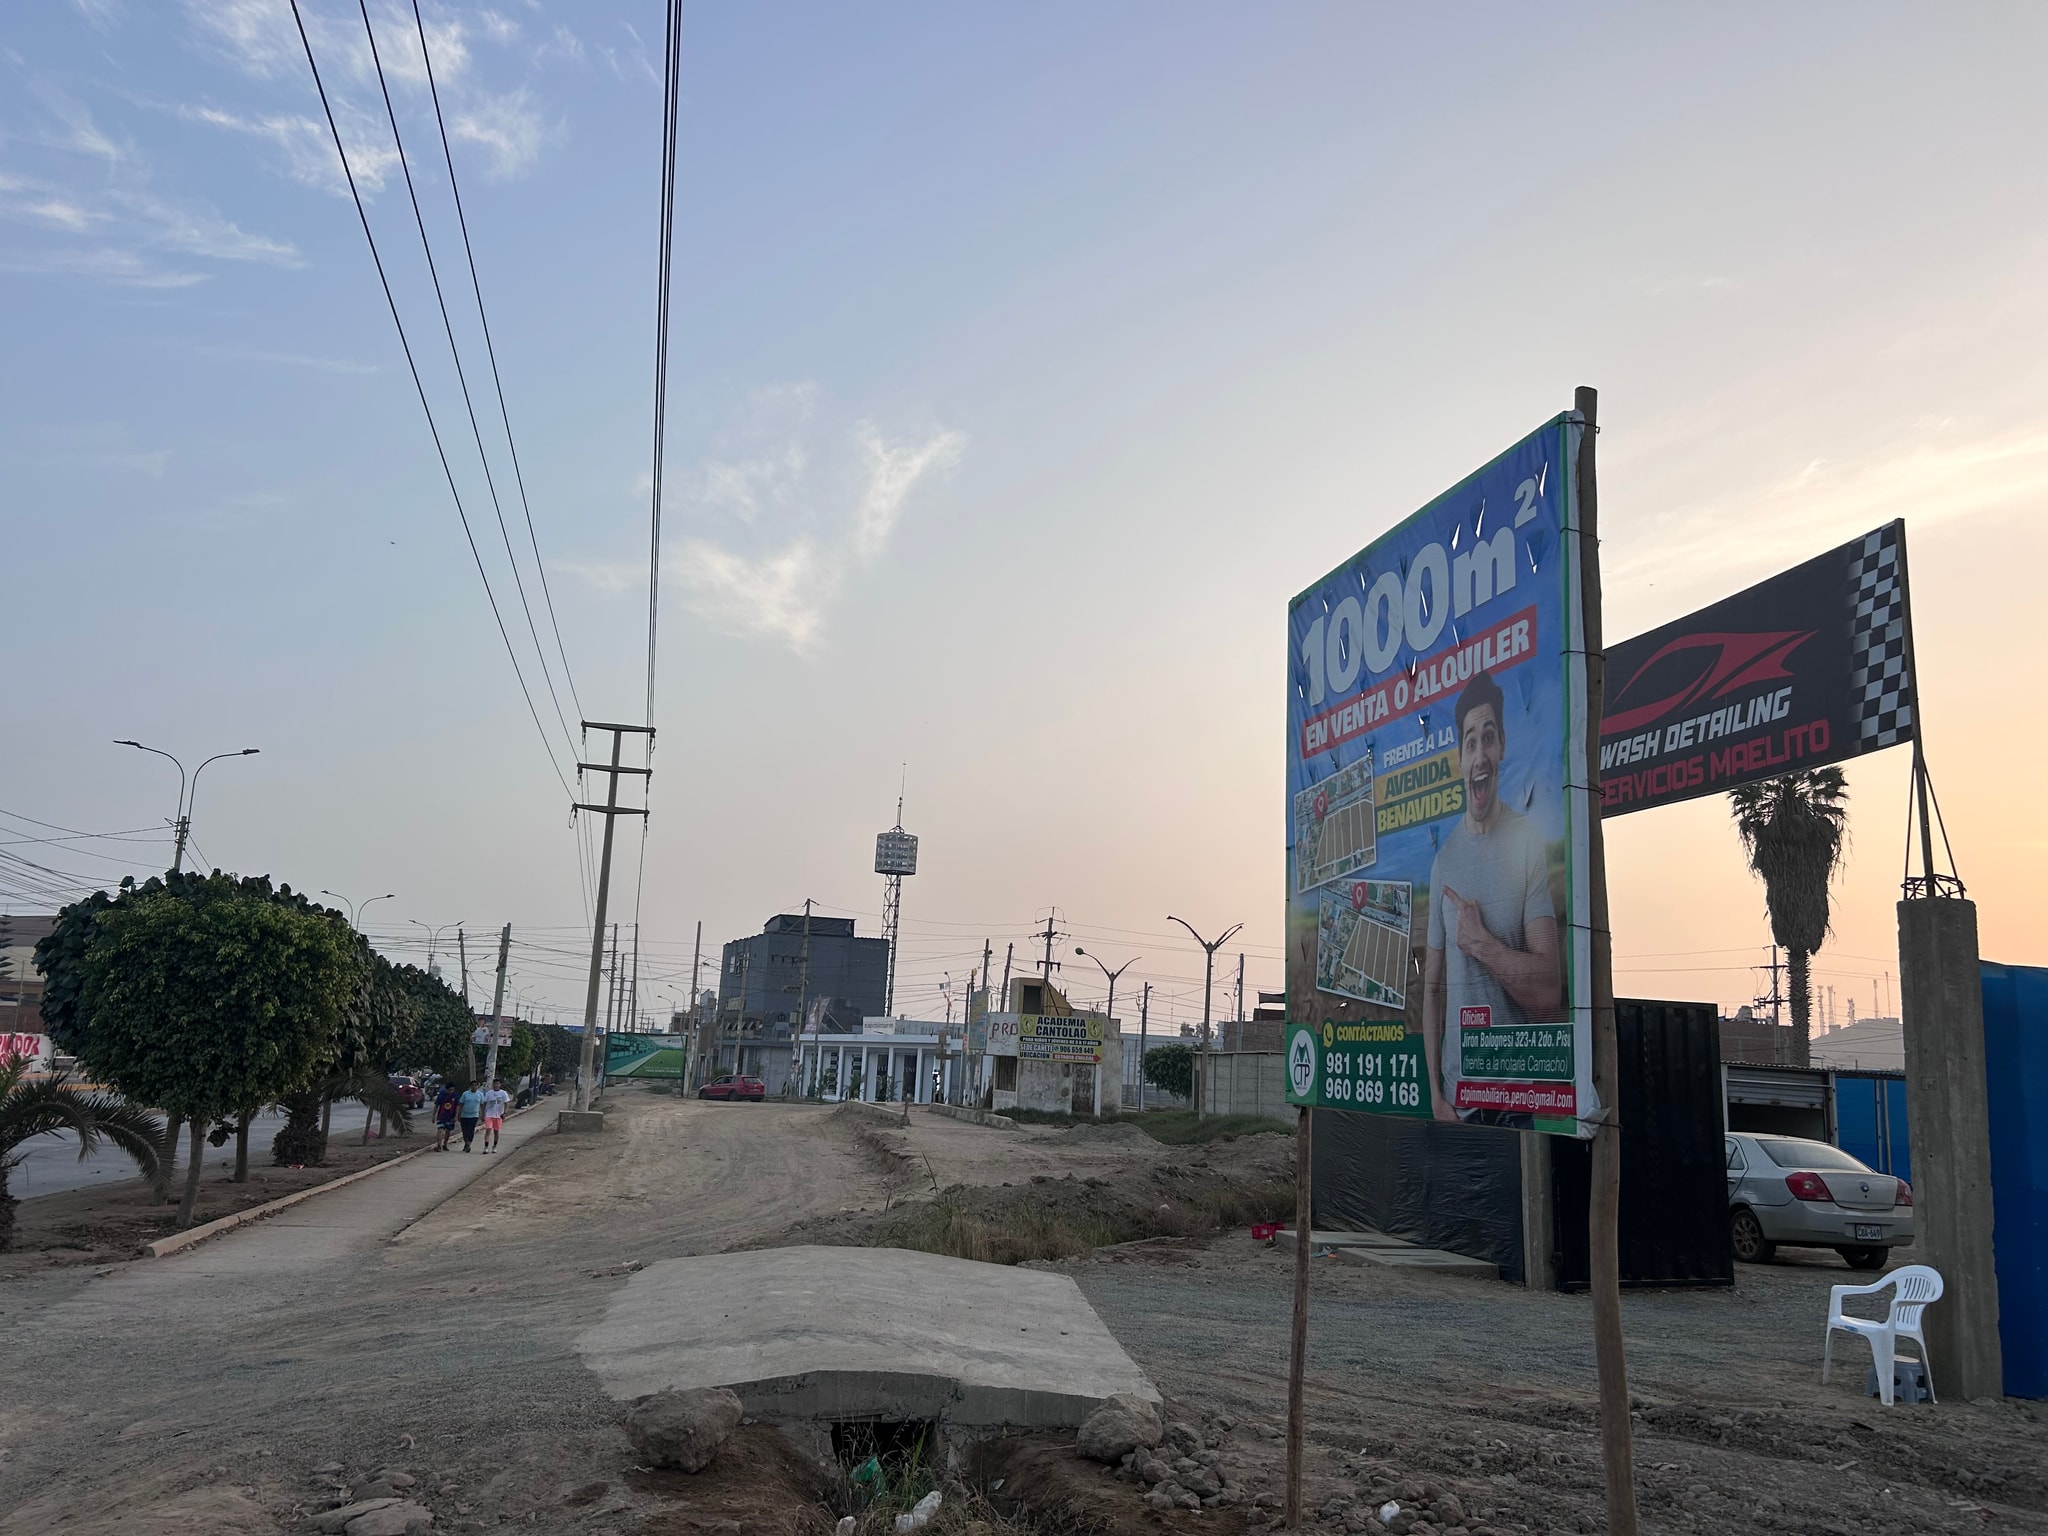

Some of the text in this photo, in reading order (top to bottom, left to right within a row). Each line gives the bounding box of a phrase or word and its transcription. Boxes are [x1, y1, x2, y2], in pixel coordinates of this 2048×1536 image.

[1306, 619, 1531, 751] EN VENTA O ALQUILER
[1600, 686, 1793, 771] WASH DETAILING
[1383, 726, 1455, 769] FRENTE A LA
[1709, 719, 1831, 781] MAELITO
[1384, 757, 1452, 800] AVENIDA
[1377, 784, 1463, 833] BENAVIDES
[1037, 1016, 1086, 1027] ACADEMIA
[1336, 1021, 1404, 1041] CONTÁCTANOS
[1462, 1009, 1487, 1026] Oficina:
[1036, 1026, 1087, 1039] CANTOLAO
[1480, 1031, 1514, 1051] Bolognesi
[1515, 1031, 1537, 1048] 323-A
[1538, 1030, 1555, 1048] 2do.
[1326, 1052, 1417, 1078] 981 191 171
[1485, 1060, 1491, 1070] a
[1492, 1056, 1499, 1071] la
[1527, 1055, 1569, 1077] Camacho)
[1325, 1077, 1420, 1107] 960 869 168
